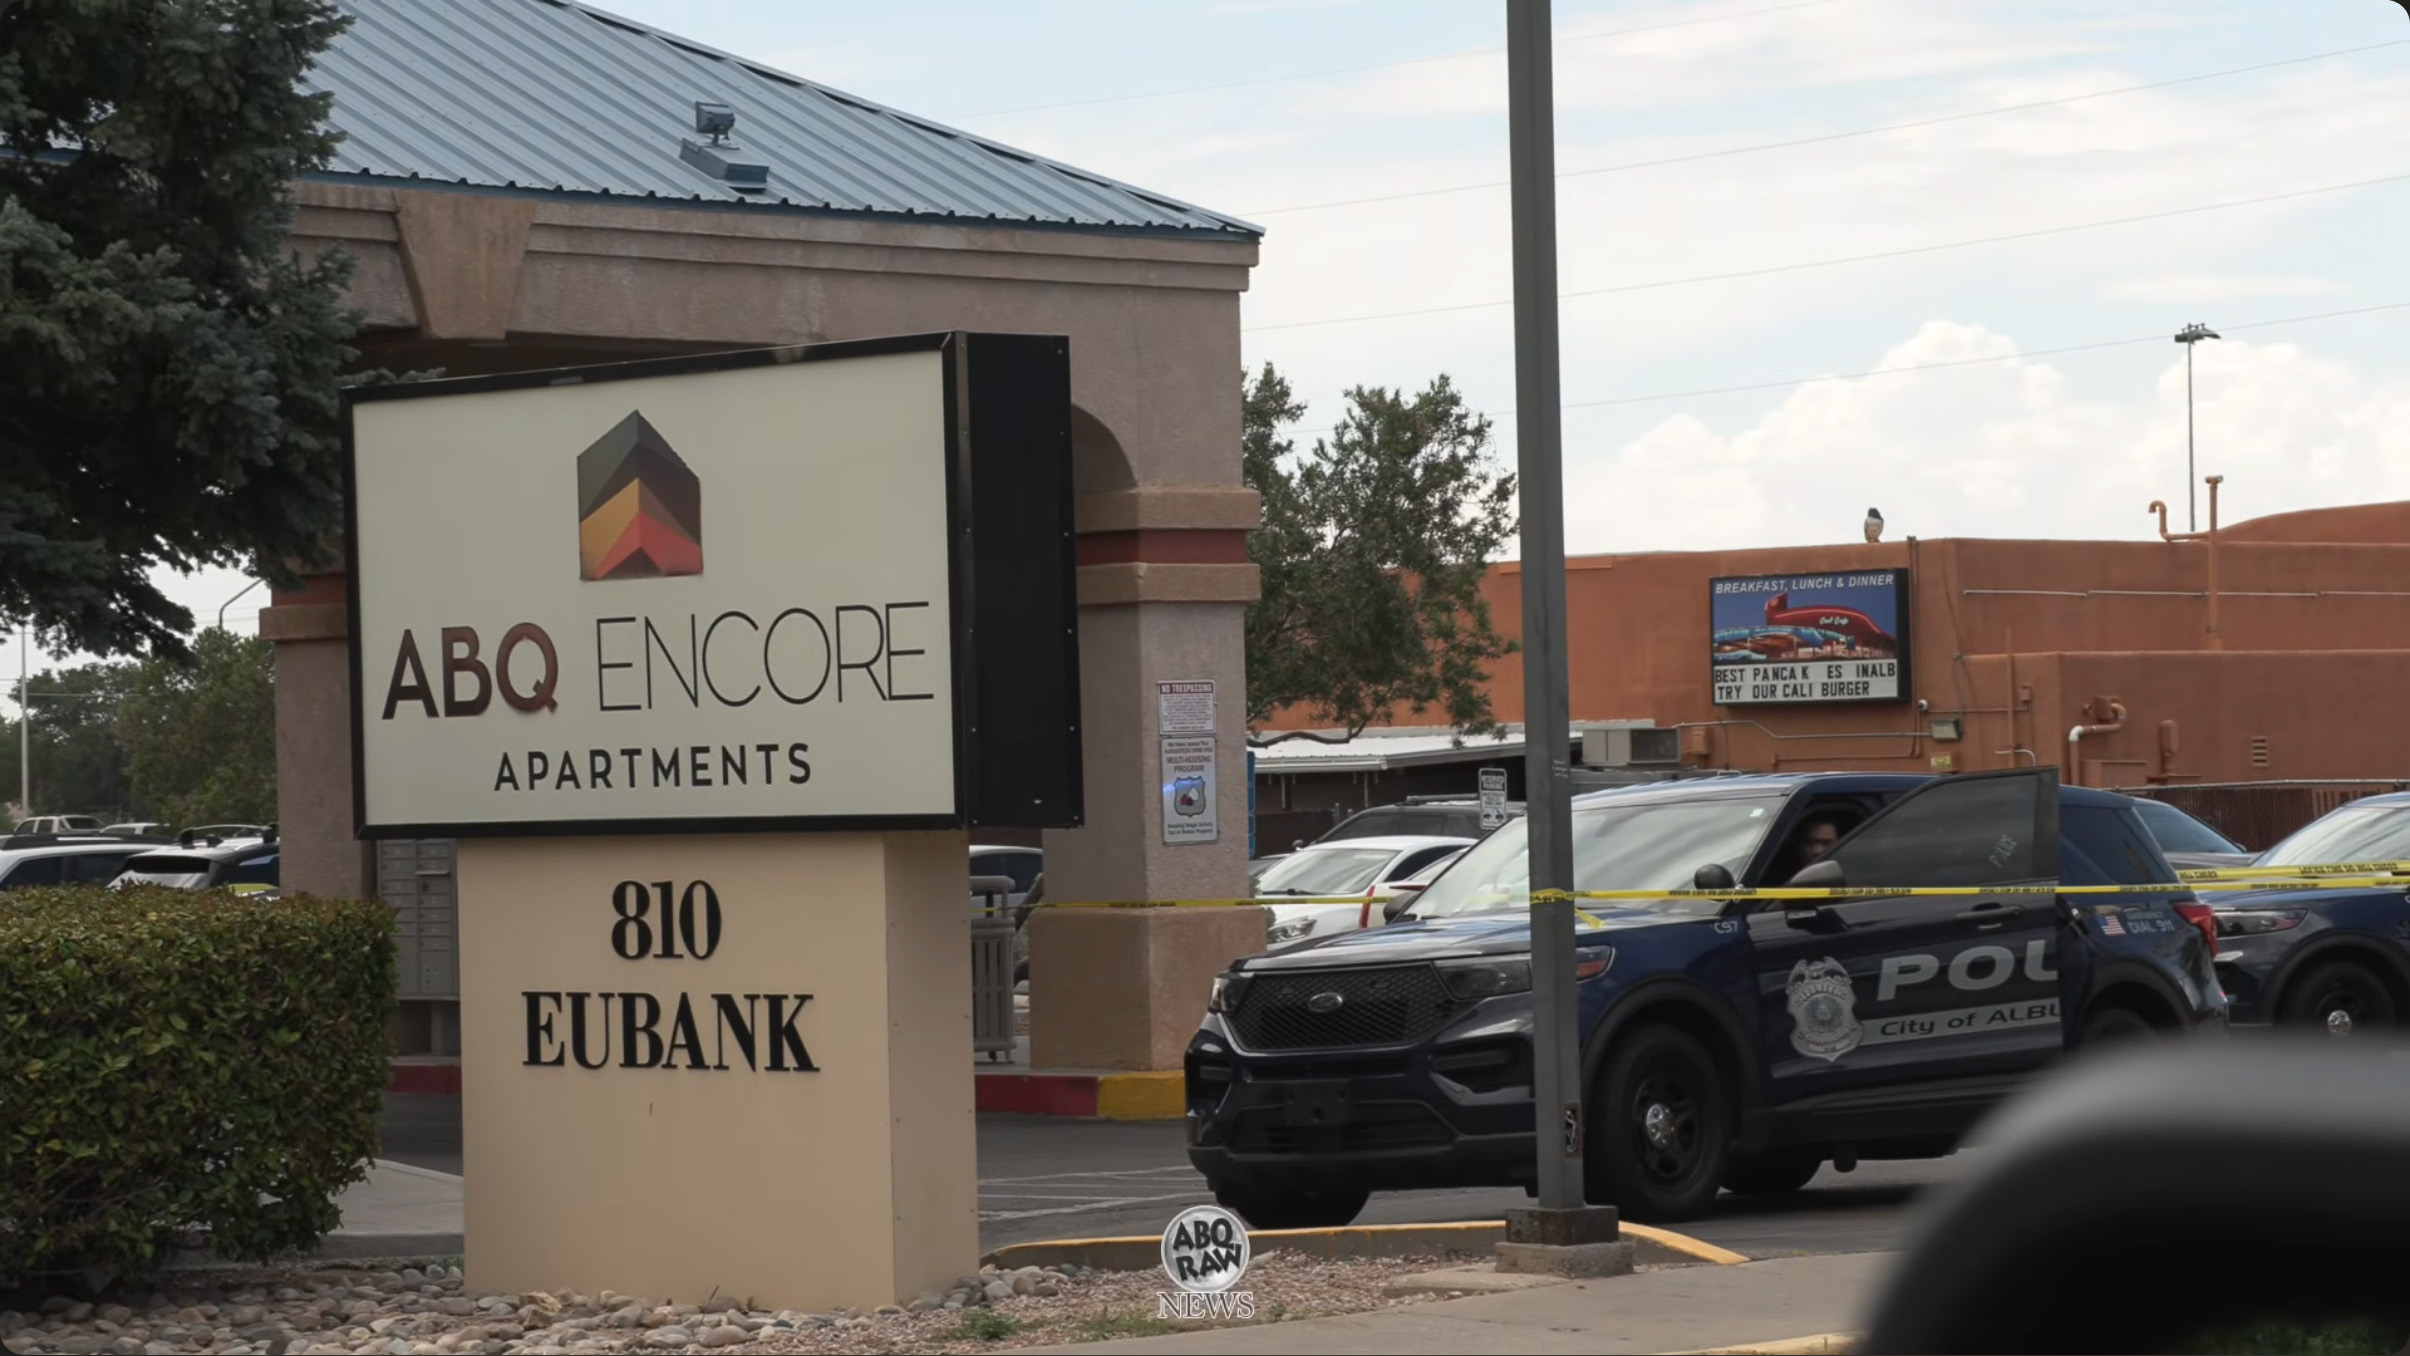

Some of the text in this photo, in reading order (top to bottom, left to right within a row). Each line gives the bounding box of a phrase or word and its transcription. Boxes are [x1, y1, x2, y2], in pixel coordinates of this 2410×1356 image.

[1715, 574, 1894, 594] BREAKFAST, LUNCH & DINNER
[382, 601, 934, 720] ABQ ENCORE
[1715, 668, 1745, 683] BEST
[1161, 683, 1213, 693] NO TRESPASSING
[1718, 681, 1870, 700] TRY OUR CALI BURGER
[494, 743, 812, 791] APARTMENTS
[1166, 755, 1212, 764] MULTI-HOUSING
[611, 879, 722, 961] 810
[2127, 919, 2176, 934] DIAL 911
[1876, 939, 2058, 1001] POL
[521, 991, 821, 1073] EUBANK
[1880, 1019, 1936, 1037] City
[1947, 1014, 1975, 1029] of
